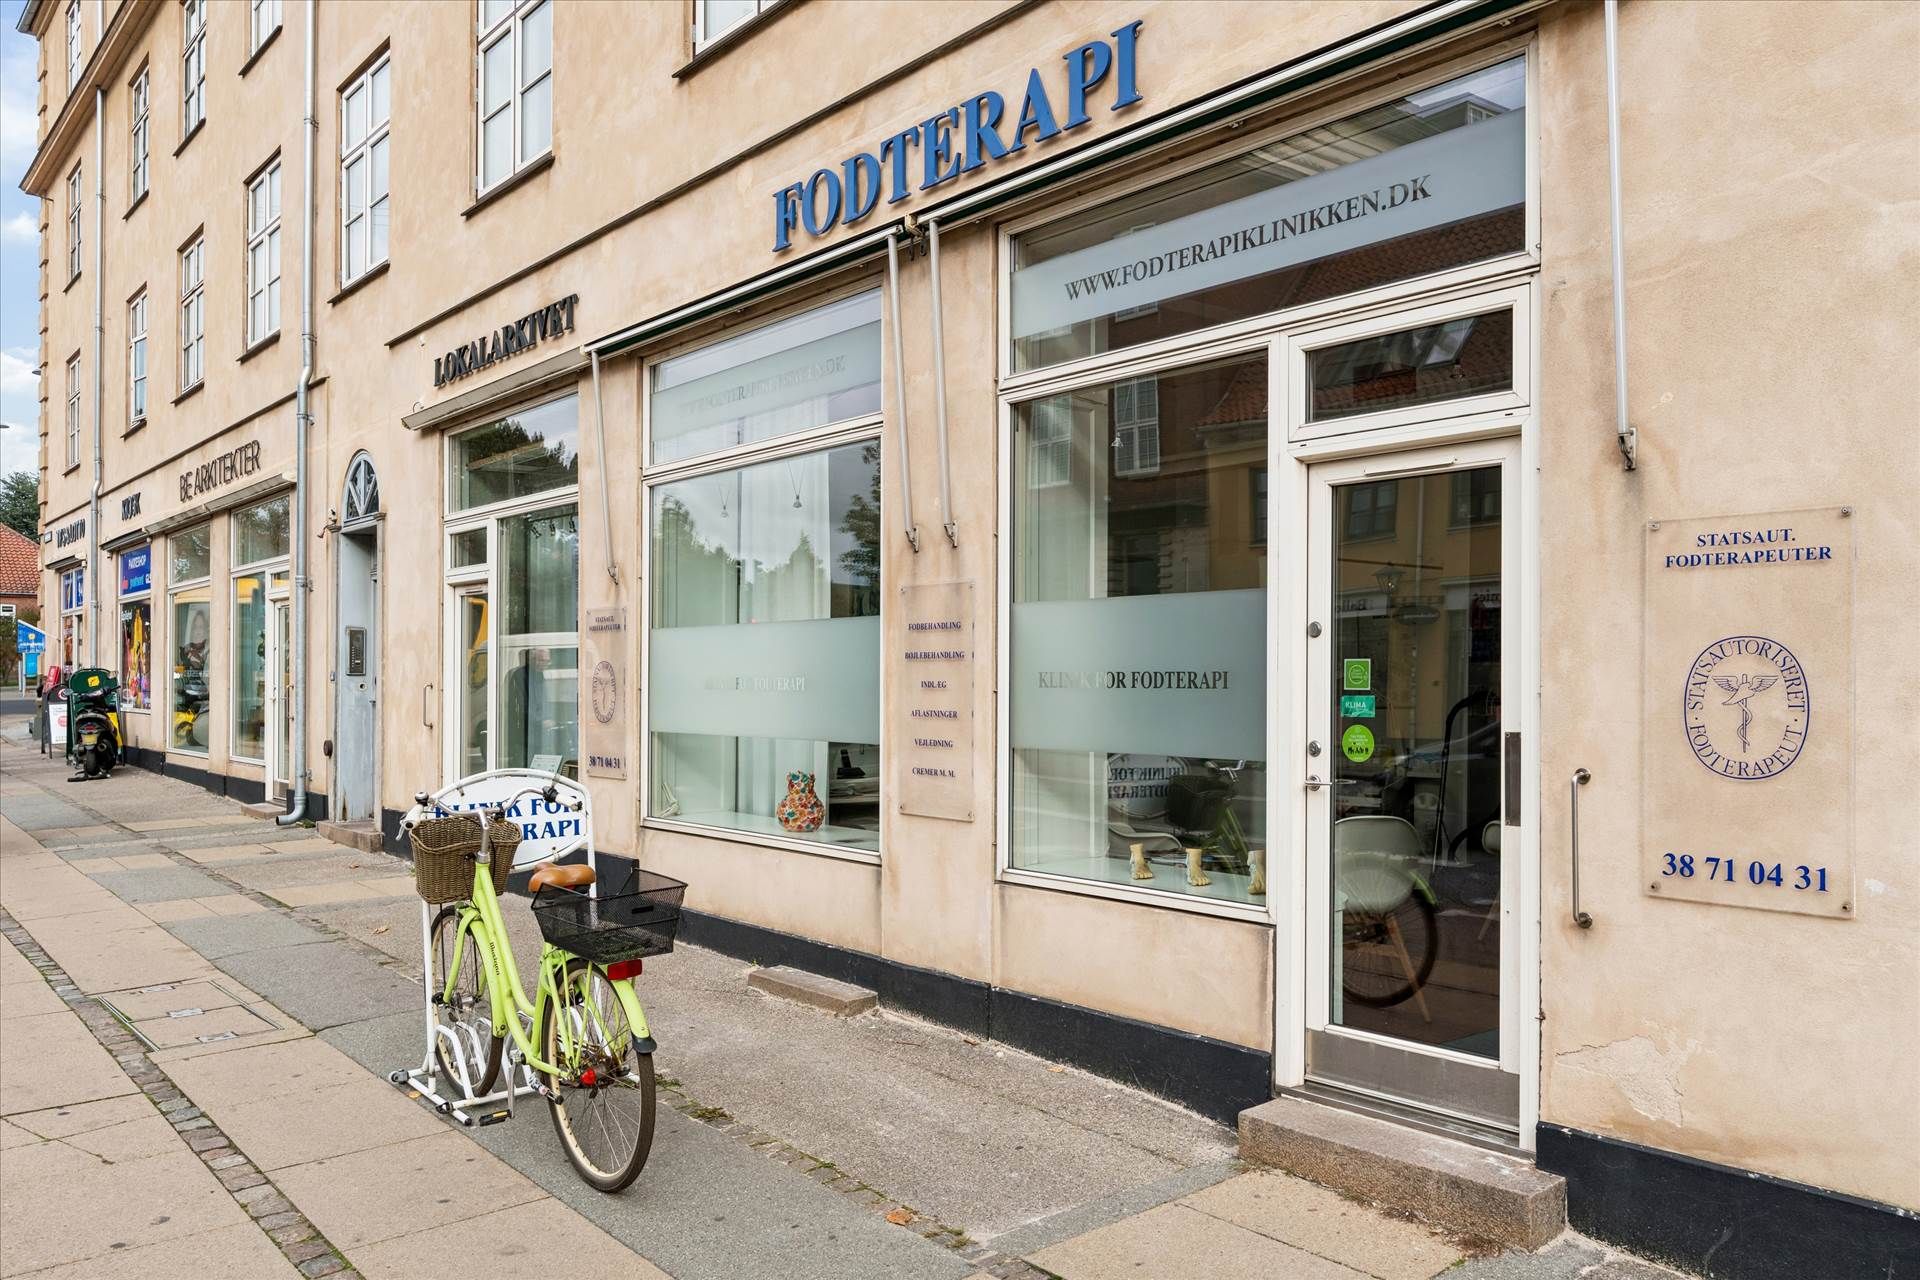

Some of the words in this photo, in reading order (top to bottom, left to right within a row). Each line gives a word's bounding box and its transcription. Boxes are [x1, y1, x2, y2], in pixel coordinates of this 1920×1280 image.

[772, 19, 1144, 253] FODTERAPI
[1065, 174, 1432, 301] WWW.FODTERAPIKLINIKKEN.DK
[434, 294, 579, 387] LOKALARKIVET
[180, 471, 193, 503] BE
[194, 440, 261, 496] ARKITEKTER
[1696, 528, 1796, 547] STATSAUT.
[1665, 546, 1833, 568] FODTERAPEUTER
[908, 621, 961, 631] FODBEHANDLING
[1131, 671, 1230, 689] FODTERAPI
[1689, 639, 1806, 712] STATSAUTORISERET
[911, 709, 958, 719] AFLASTNINGER
[914, 738, 953, 748] VEJLEDNING
[1689, 724, 1804, 777] FODTERAPEUT
[597, 756, 604, 768] 71
[605, 757, 612, 768] 04
[613, 757, 620, 769] 31
[912, 767, 938, 776] CREMER
[1662, 852, 1695, 878] 38
[1704, 856, 1737, 883] 71
[1748, 860, 1784, 887] 04
[1794, 865, 1828, 893] 31
